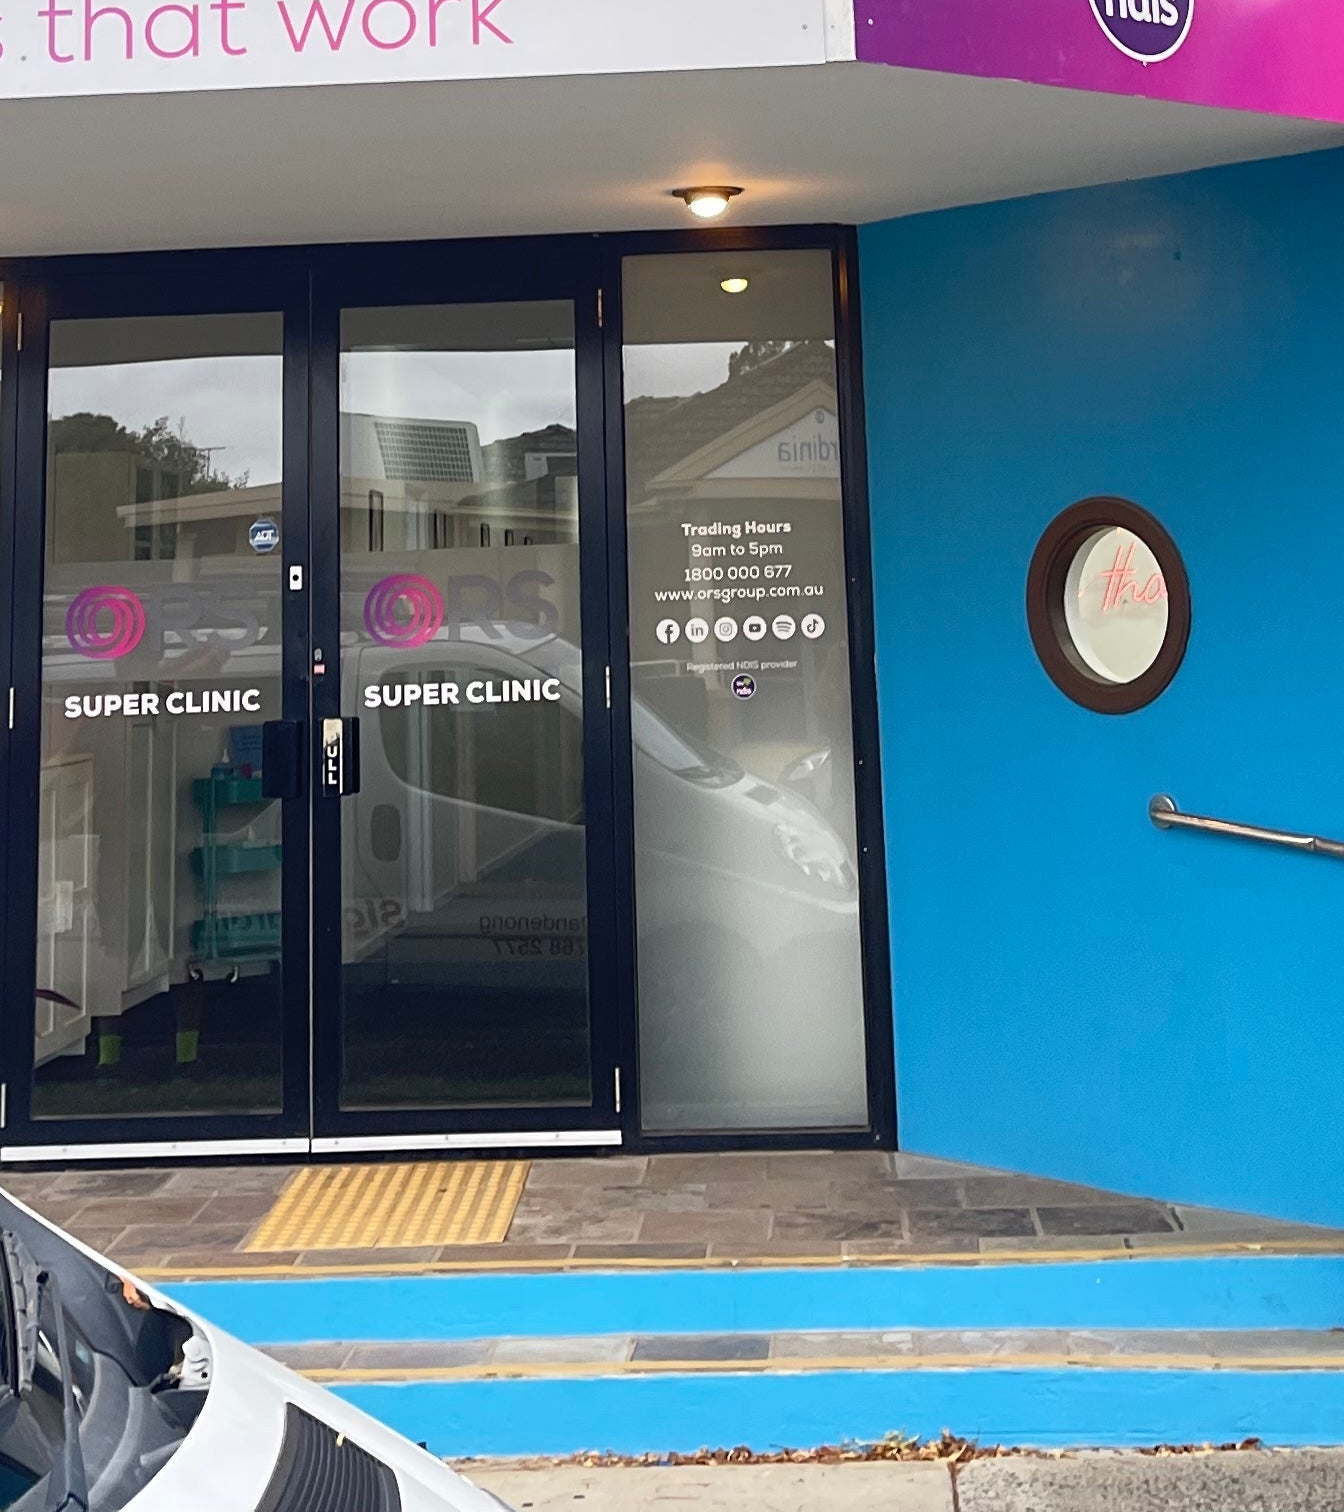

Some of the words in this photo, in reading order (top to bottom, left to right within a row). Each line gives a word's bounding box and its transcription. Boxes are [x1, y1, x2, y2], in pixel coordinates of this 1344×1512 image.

[254, 529, 275, 542] ADT
[681, 522, 742, 539] Trading
[744, 520, 792, 535] Hours
[691, 543, 727, 557] 9am
[730, 545, 746, 556] to
[748, 541, 784, 558] 5pm
[684, 567, 724, 582] 1800
[727, 565, 760, 580] 000
[763, 564, 793, 579] 677
[654, 584, 825, 604] www.orsgroup.com.au
[363, 569, 561, 649] ORS
[364, 681, 460, 709] SUPER
[465, 678, 562, 704] CLINIC
[64, 693, 160, 720] SUPER
[165, 688, 262, 715] CLINIC
[326, 734, 339, 785] ULL
